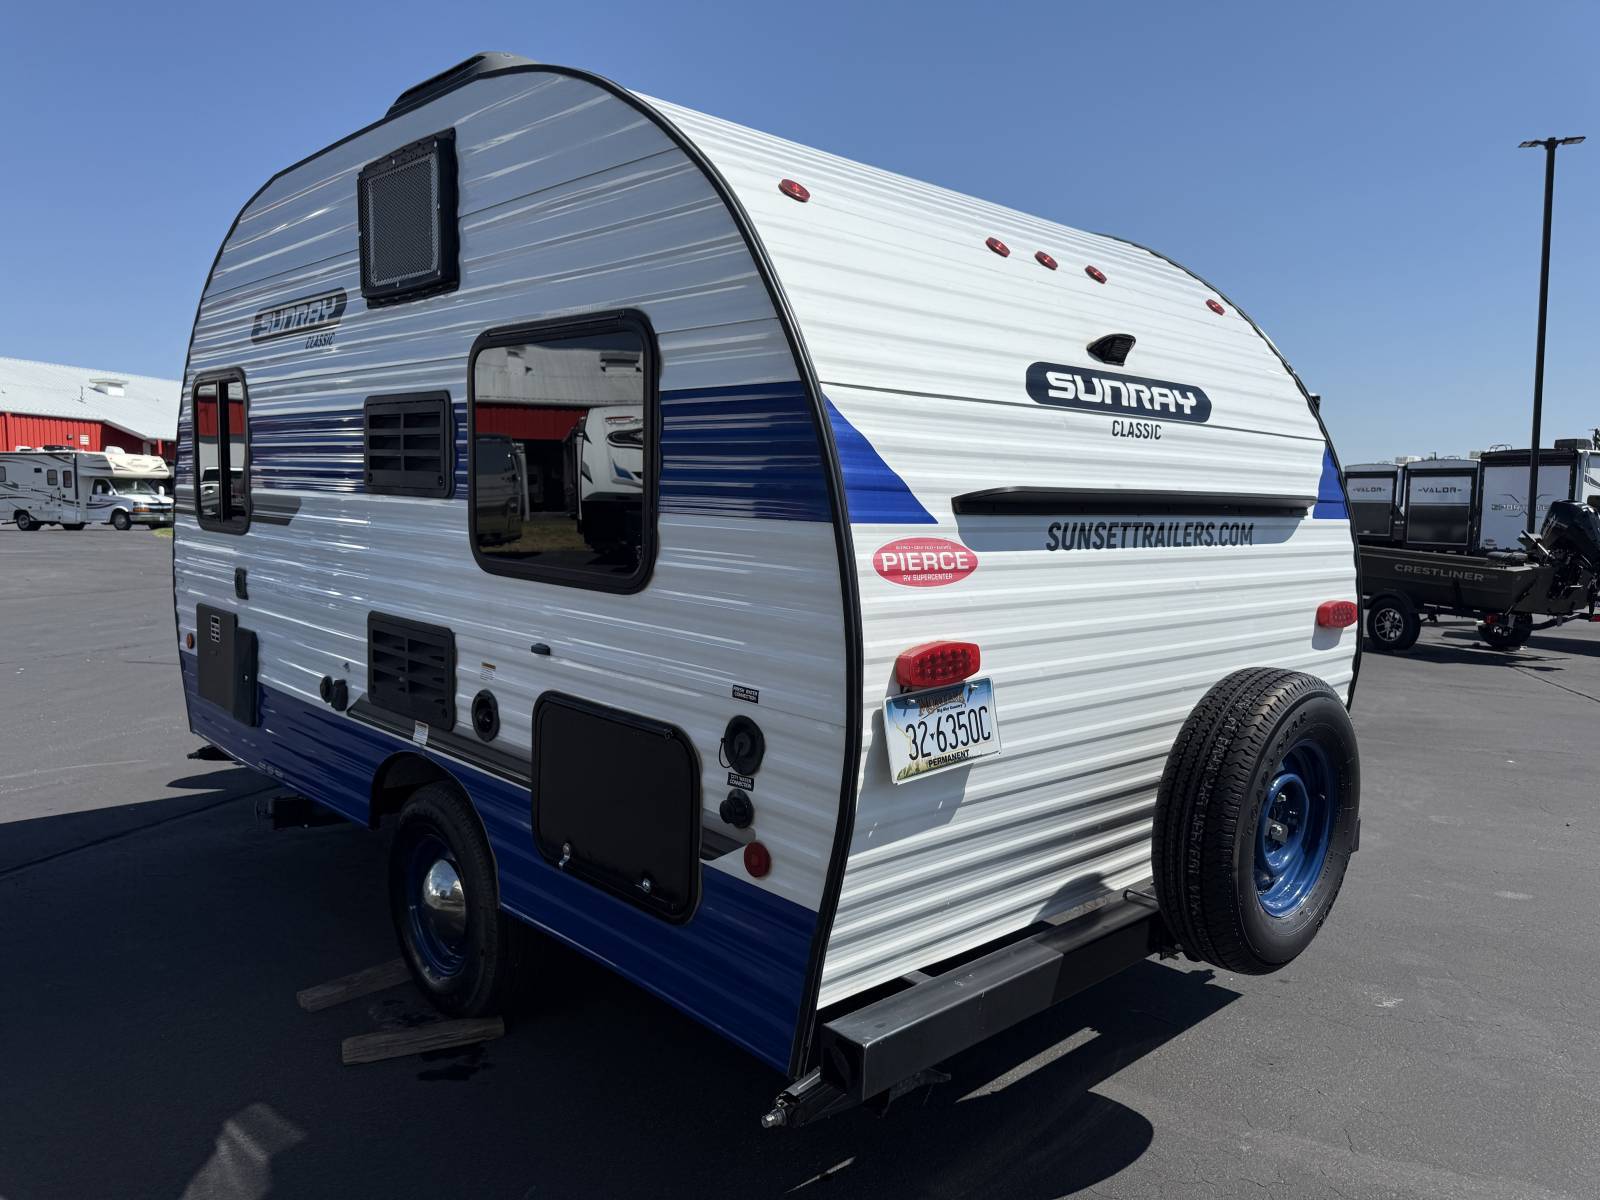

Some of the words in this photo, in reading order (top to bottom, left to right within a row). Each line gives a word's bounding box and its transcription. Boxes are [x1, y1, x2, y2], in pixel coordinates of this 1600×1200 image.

[259, 296, 337, 336] SUNRAY
[305, 332, 336, 349] CLASSIC
[1045, 371, 1197, 415] SUNRAY
[1112, 420, 1162, 440] CLASSIC
[1421, 486, 1457, 494] VALOR
[1046, 521, 1254, 551] SUNSETTRAILERS.COM
[881, 551, 970, 572] PIERCE
[903, 574, 911, 582] RV
[912, 572, 953, 581] SUPERCENTER
[1394, 563, 1484, 581] CRESTLINER
[928, 749, 970, 768] PERMANENT
